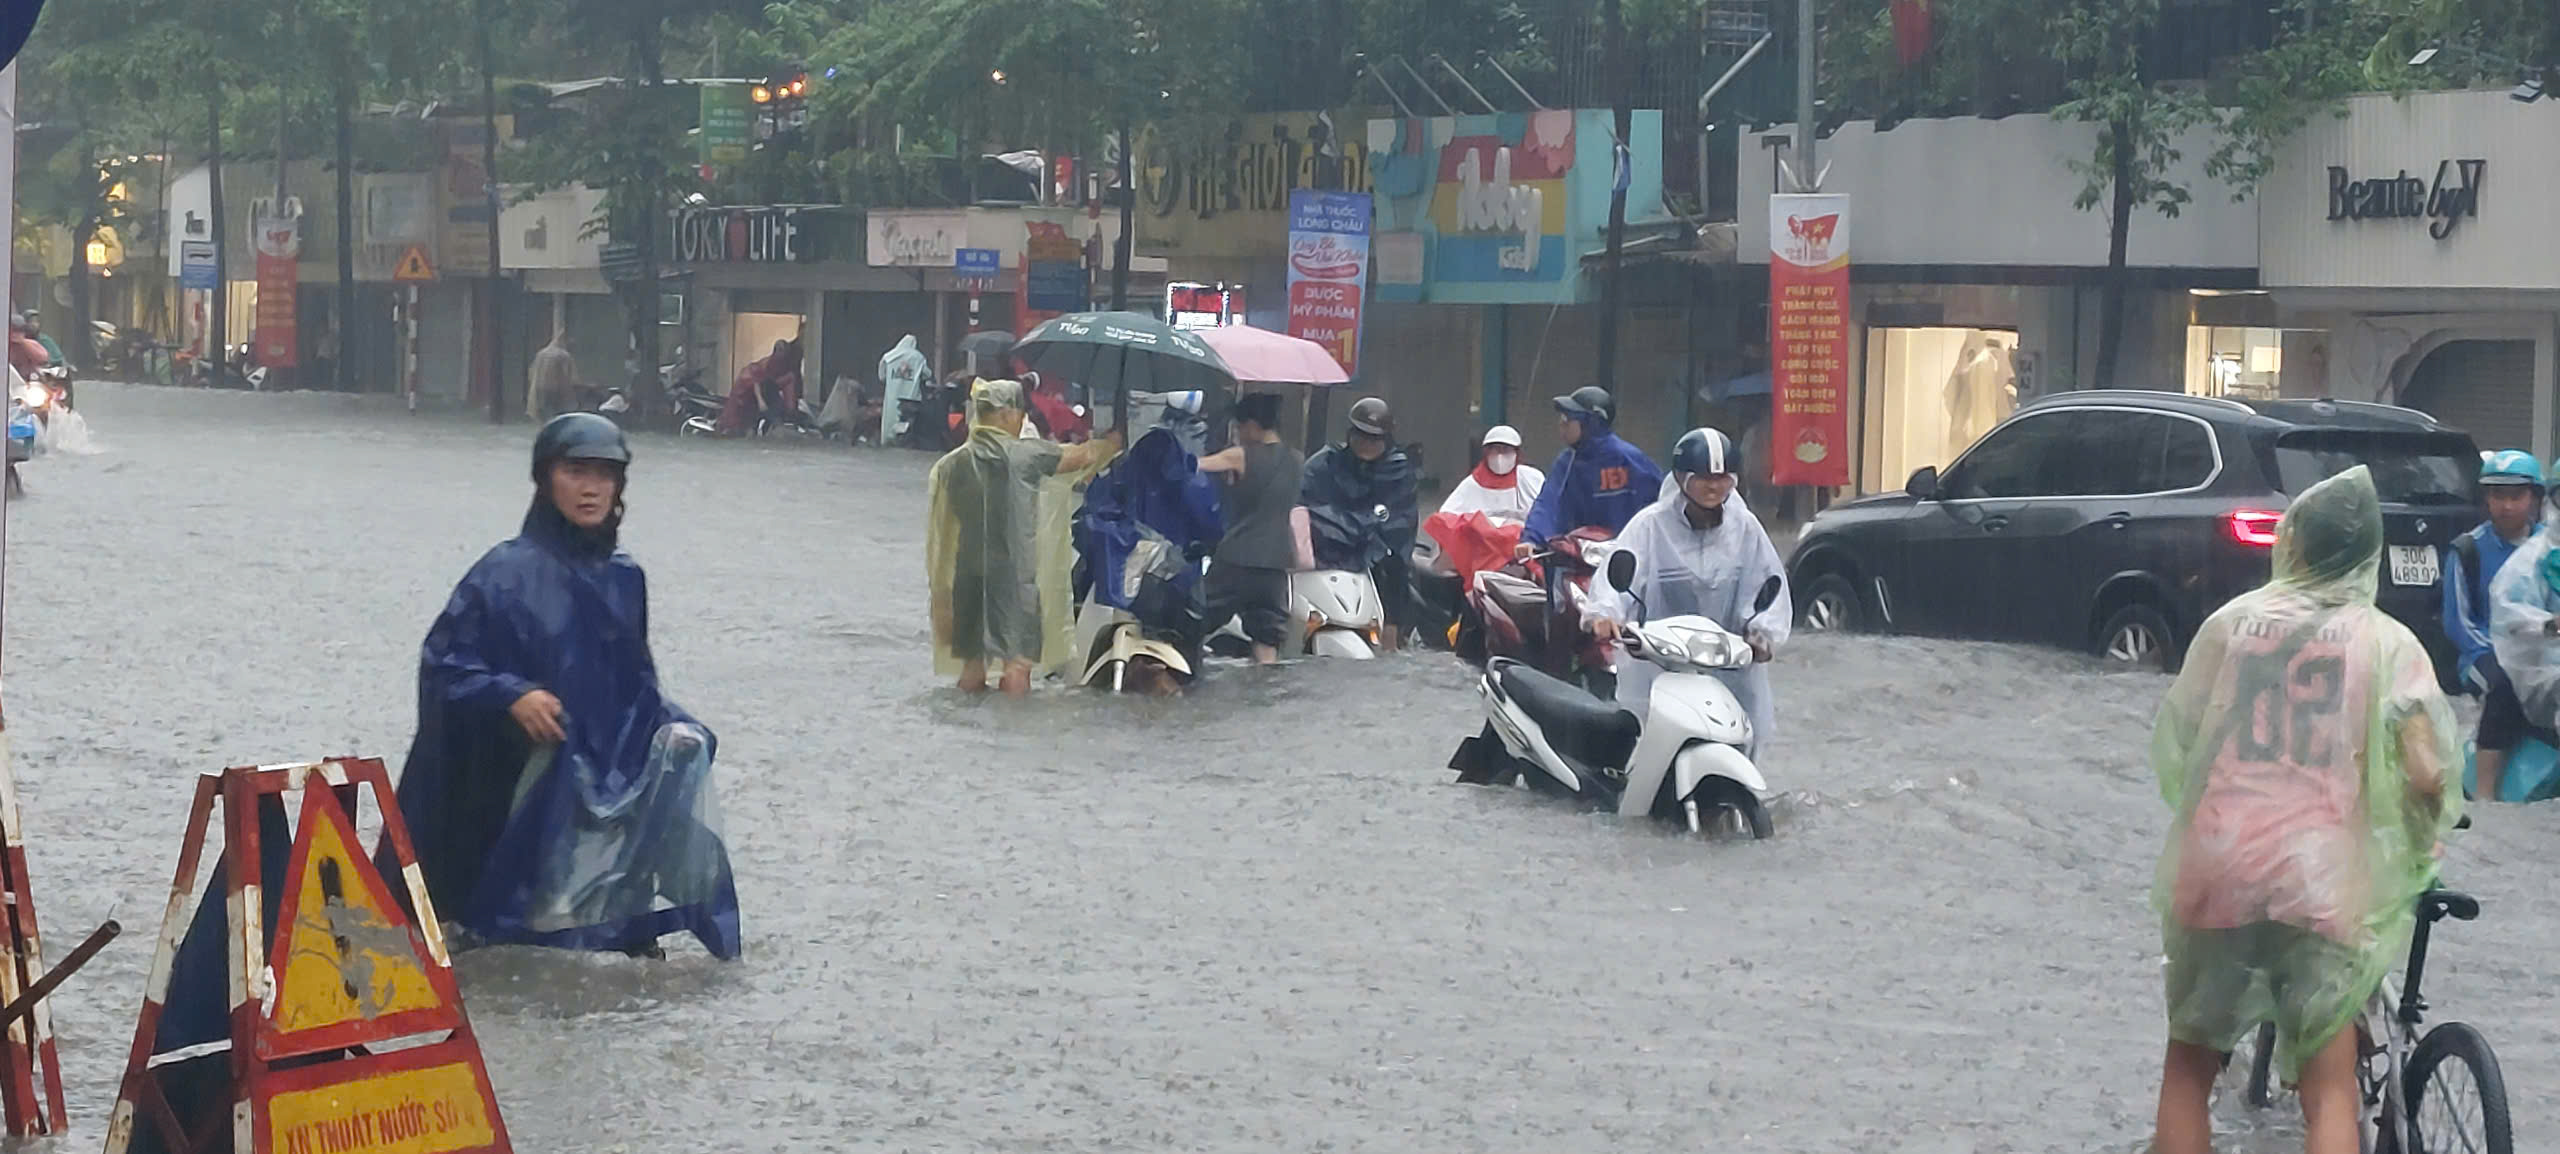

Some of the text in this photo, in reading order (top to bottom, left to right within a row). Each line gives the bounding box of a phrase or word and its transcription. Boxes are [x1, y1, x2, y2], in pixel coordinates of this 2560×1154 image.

[1298, 218, 1329, 230] LONG
[1303, 328, 1336, 341] MUA
[1337, 328, 1354, 363] 1
